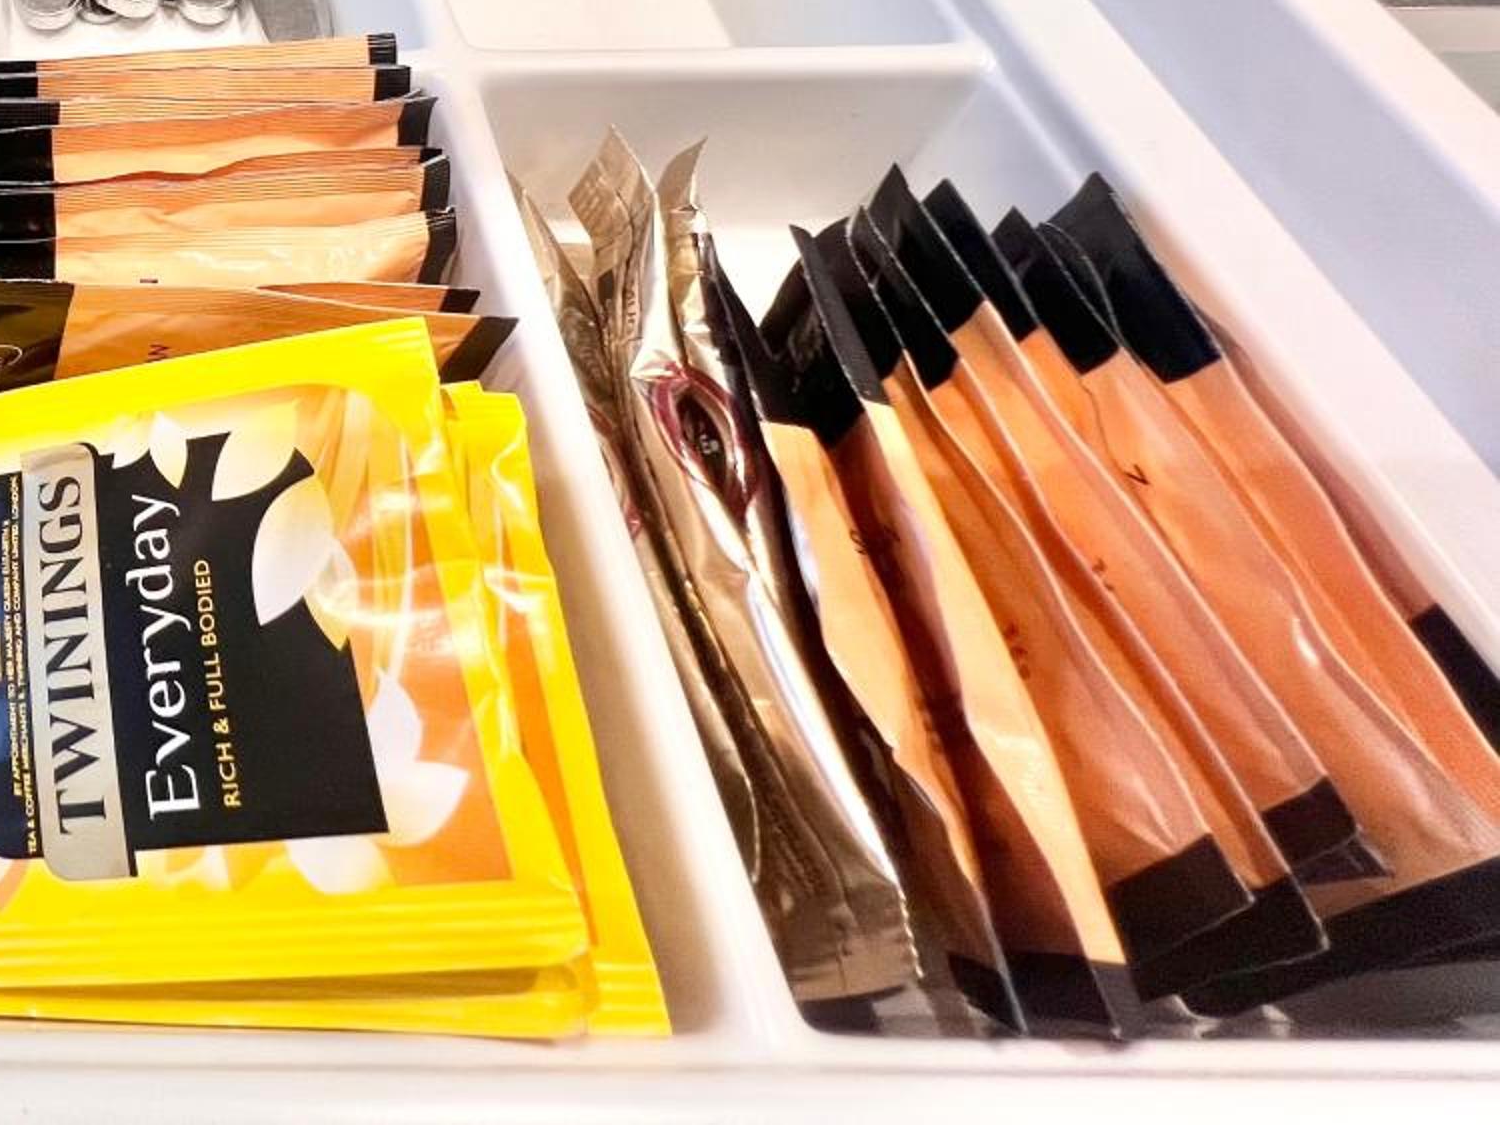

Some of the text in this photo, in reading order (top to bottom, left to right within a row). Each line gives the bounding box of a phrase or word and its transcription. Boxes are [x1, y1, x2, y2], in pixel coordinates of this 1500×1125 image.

[38, 473, 108, 836] TWININGS
[125, 494, 200, 821] Everyday
[193, 558, 243, 808] RICH & FULL BODIED
